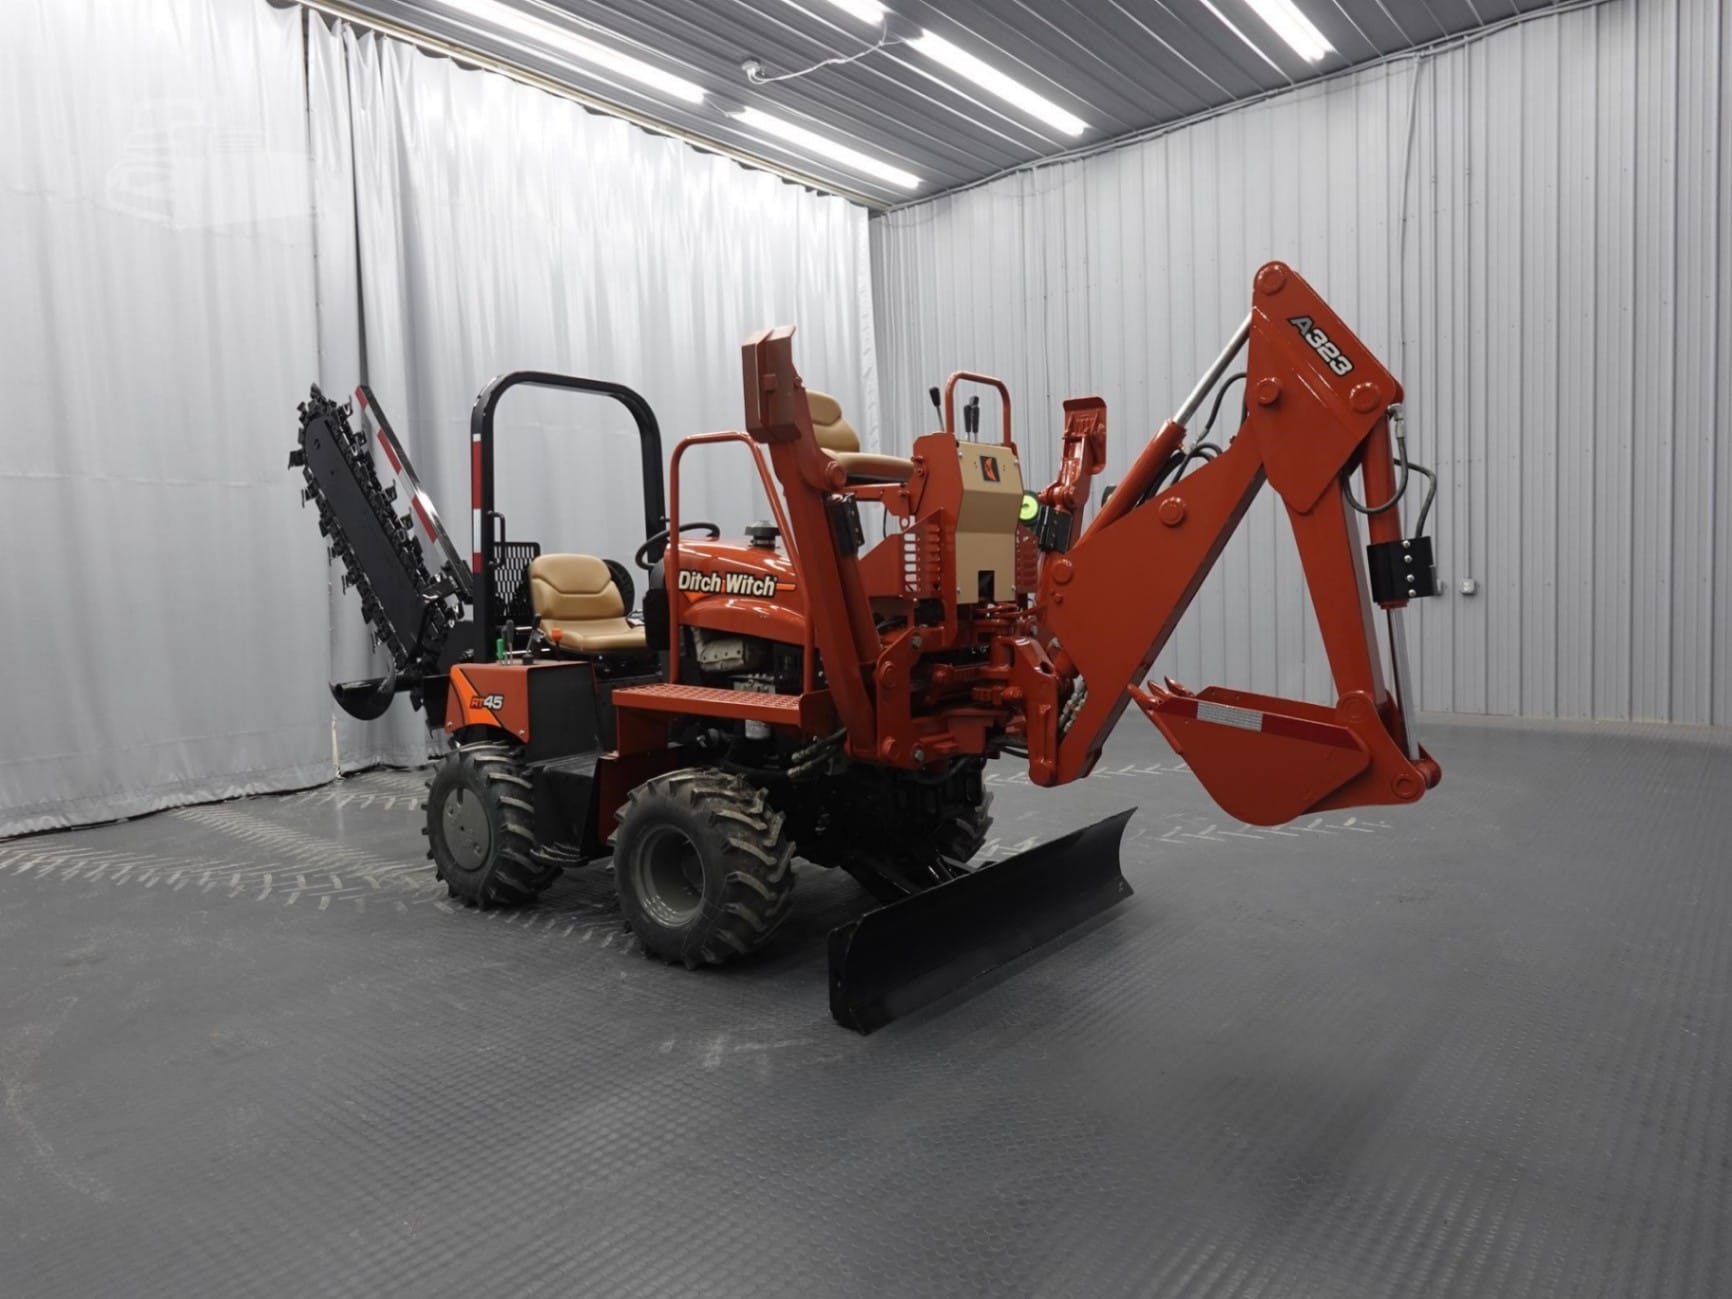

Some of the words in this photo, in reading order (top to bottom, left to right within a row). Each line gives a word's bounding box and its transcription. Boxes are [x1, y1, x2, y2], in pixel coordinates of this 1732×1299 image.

[1288, 316, 1354, 376] A323
[678, 570, 722, 593] Ditch
[725, 572, 775, 597] Witch
[471, 695, 504, 709] RT45
